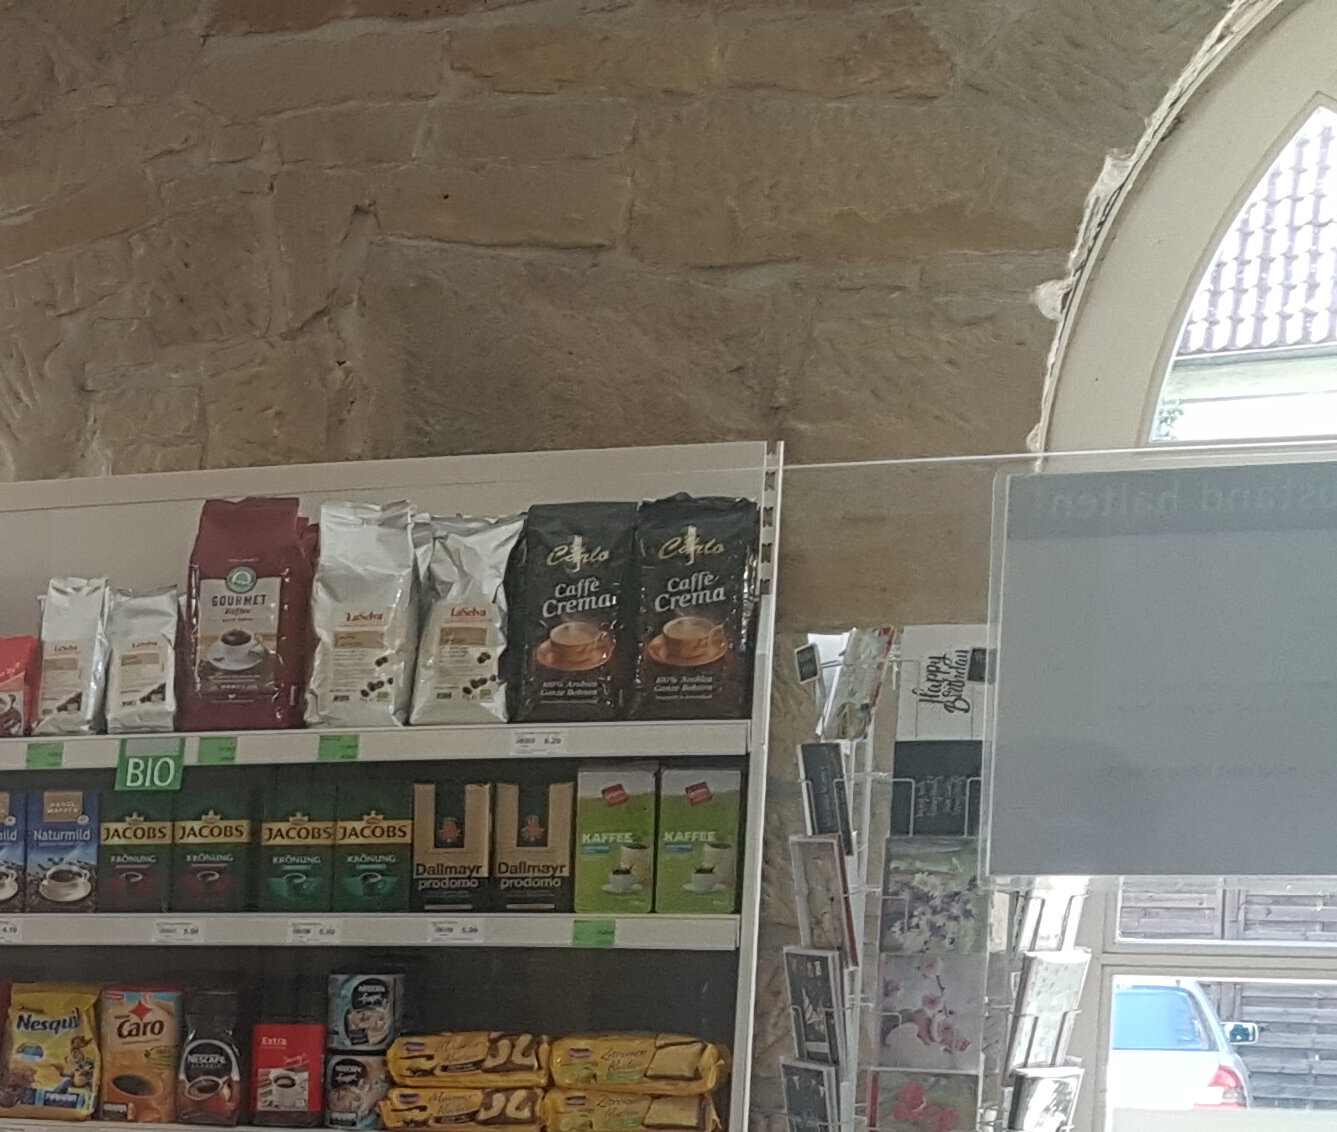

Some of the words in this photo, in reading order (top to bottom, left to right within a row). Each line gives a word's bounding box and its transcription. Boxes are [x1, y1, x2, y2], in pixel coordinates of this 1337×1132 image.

[211, 594, 267, 607] GOURMET
[542, 593, 611, 618] Crema
[654, 586, 726, 613] Crema
[912, 653, 953, 703] Happy
[126, 757, 176, 787] BIO
[33, 828, 91, 842] Naturmild
[103, 825, 168, 841] JACOBS
[178, 824, 245, 840] JACOBS
[264, 825, 333, 841] JACOBS
[338, 824, 409, 840] JACOBS
[582, 832, 633, 844] KAFFEE
[664, 831, 715, 842] KAFFEE
[415, 863, 482, 878] Dallmayr
[498, 861, 566, 877] Dallmayr
[417, 877, 479, 890] prodomo
[500, 876, 562, 889] prodomo
[117, 1019, 165, 1039] Caro
[262, 1036, 287, 1046] Extra
